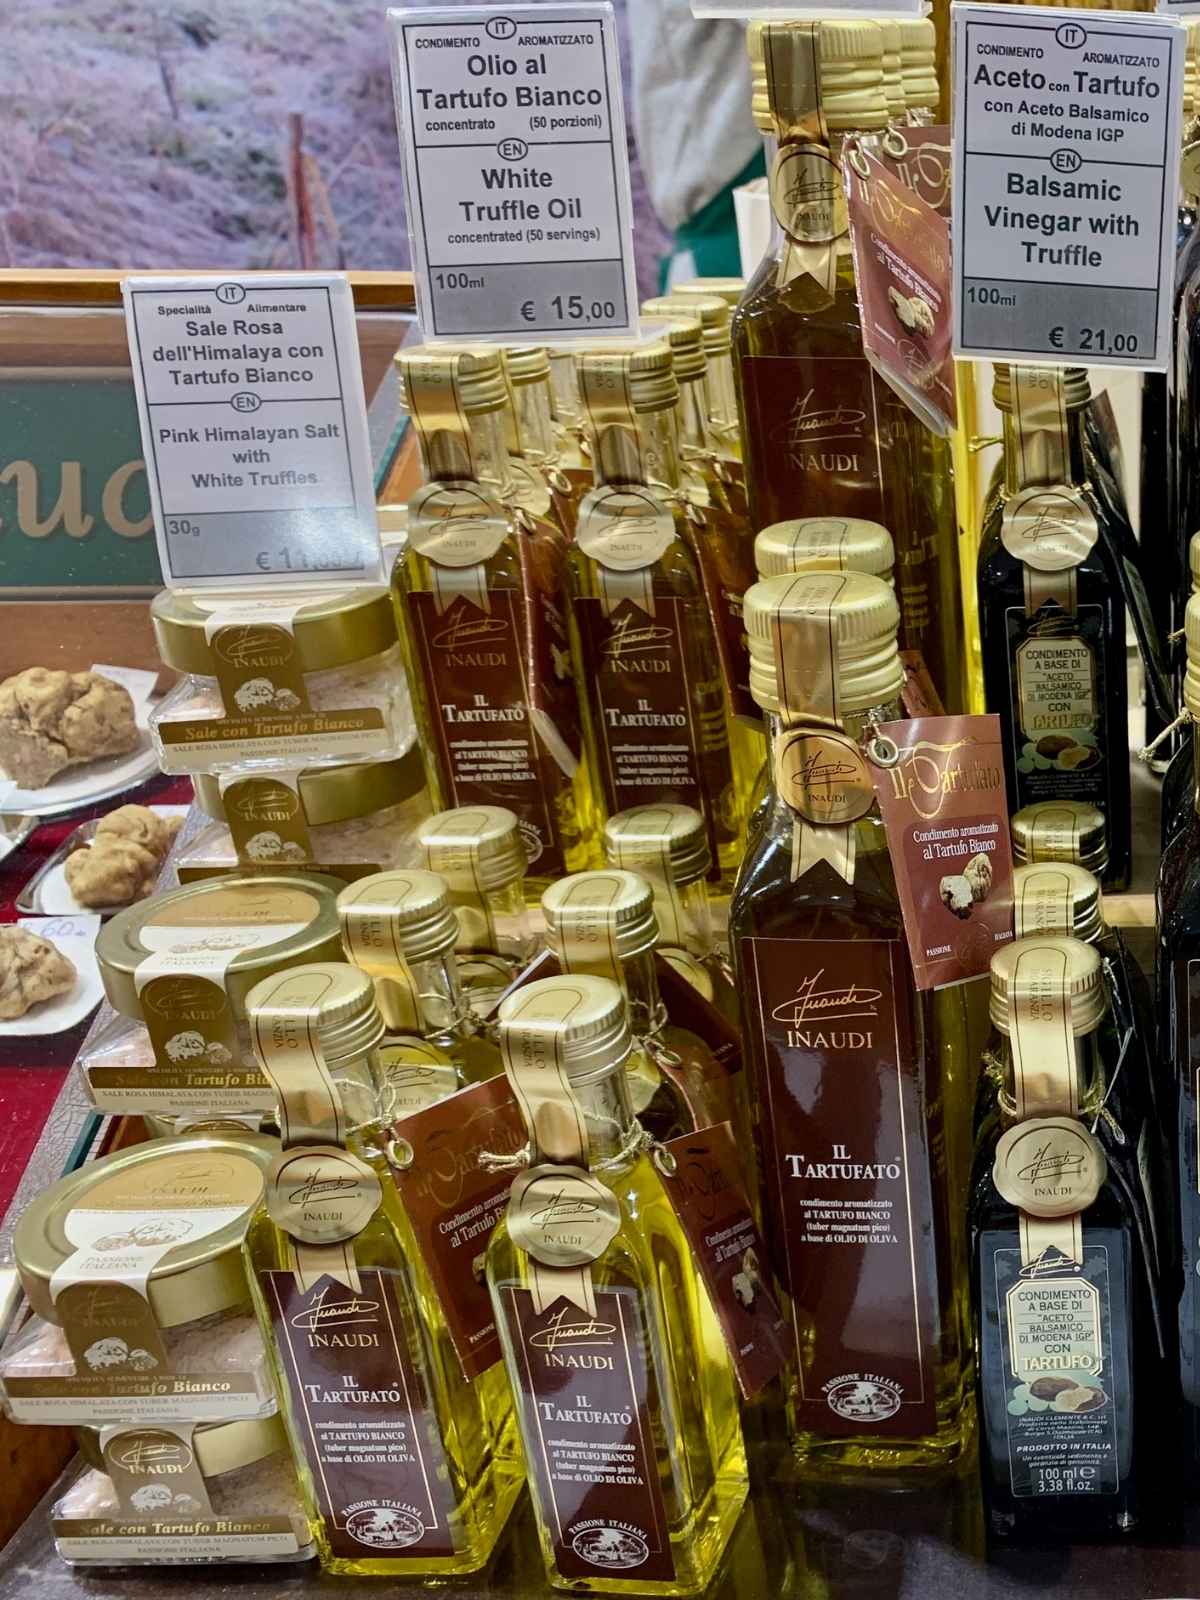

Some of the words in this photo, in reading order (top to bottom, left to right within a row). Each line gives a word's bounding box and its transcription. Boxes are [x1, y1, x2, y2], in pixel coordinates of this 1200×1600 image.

[415, 37, 480, 49] CONDIMENTO
[517, 35, 593, 46] AROMATIZZATO
[1065, 30, 1078, 43] IT
[467, 54, 517, 75] Olio
[525, 54, 546, 75] al
[976, 43, 1044, 59] CONDIMENTO
[1082, 51, 1160, 68] AROMATIZZATO
[974, 64, 1046, 90] Aceto
[1049, 82, 1070, 93] con
[1074, 71, 1160, 99] Tartufo
[416, 87, 508, 110] Tartufo
[516, 86, 602, 107] Bianco
[984, 100, 1013, 114] con
[1017, 101, 1064, 117] Aceto
[1069, 104, 1150, 123] Balsamico
[426, 119, 495, 131] concentrato
[529, 117, 547, 131] (50
[551, 114, 602, 130] porzioni)
[1011, 123, 1026, 136] di
[1031, 123, 1092, 141] Modena
[1097, 128, 1124, 143] IGP
[502, 143, 523, 156] EN
[1055, 154, 1076, 168] EN
[481, 168, 553, 189] White
[1007, 173, 1122, 202] Balsamic
[459, 200, 540, 221] Truffle
[548, 198, 582, 219] Oil
[984, 205, 1082, 236] Vinegar
[1088, 214, 1140, 237] with
[448, 230, 522, 244] concentrated
[526, 230, 543, 243] (50
[546, 228, 600, 241] servings)
[1021, 241, 1102, 267] Truffle
[435, 274, 484, 289] 100ml
[967, 287, 1016, 307] 100ml
[247, 303, 306, 313] Alimentare
[520, 301, 536, 321] €
[551, 296, 615, 322] 15,00
[186, 321, 227, 337] Sale
[233, 319, 284, 335] Rosa
[1049, 326, 1064, 347] €
[1080, 329, 1137, 354] 21,00
[152, 344, 282, 363] dell'Himalaya
[288, 344, 324, 359] con
[169, 369, 239, 386] Tartufo
[245, 367, 314, 384] Bianco
[236, 396, 256, 410] EN
[159, 429, 199, 444] Pink
[205, 425, 299, 444] Himalayan
[304, 424, 340, 438] Salt
[232, 449, 270, 464] with
[191, 472, 244, 489] White
[247, 470, 318, 487] Truffles
[169, 520, 200, 536] 30g
[605, 709, 686, 727] TARTUFATO
[913, 826, 959, 842] Condimento
[923, 847, 932, 859] al
[934, 842, 968, 858] Tartufo
[970, 839, 996, 853] Bianco
[787, 1030, 873, 1049] INAUDI
[832, 1144, 851, 1160] IL
[785, 1154, 900, 1180] TARTUFATO
[812, 1211, 854, 1219] TARTUFO
[856, 1211, 890, 1219] BIANCO
[1018, 1289, 1091, 1301] CONDIMENTO
[307, 1334, 380, 1348] INAUDI
[1044, 1344, 1071, 1353] CON
[544, 1354, 614, 1370] INAUDI
[1023, 1356, 1093, 1370] TARTUFO
[342, 1376, 358, 1387] IL
[305, 1384, 400, 1404] TARTUFATO
[576, 1396, 592, 1407] IL
[539, 1402, 632, 1425] TARTUFATO
[1039, 1468, 1060, 1480] 100
[1038, 1480, 1063, 1492] 3.38
[152, 1522, 210, 1536] Tartufo
